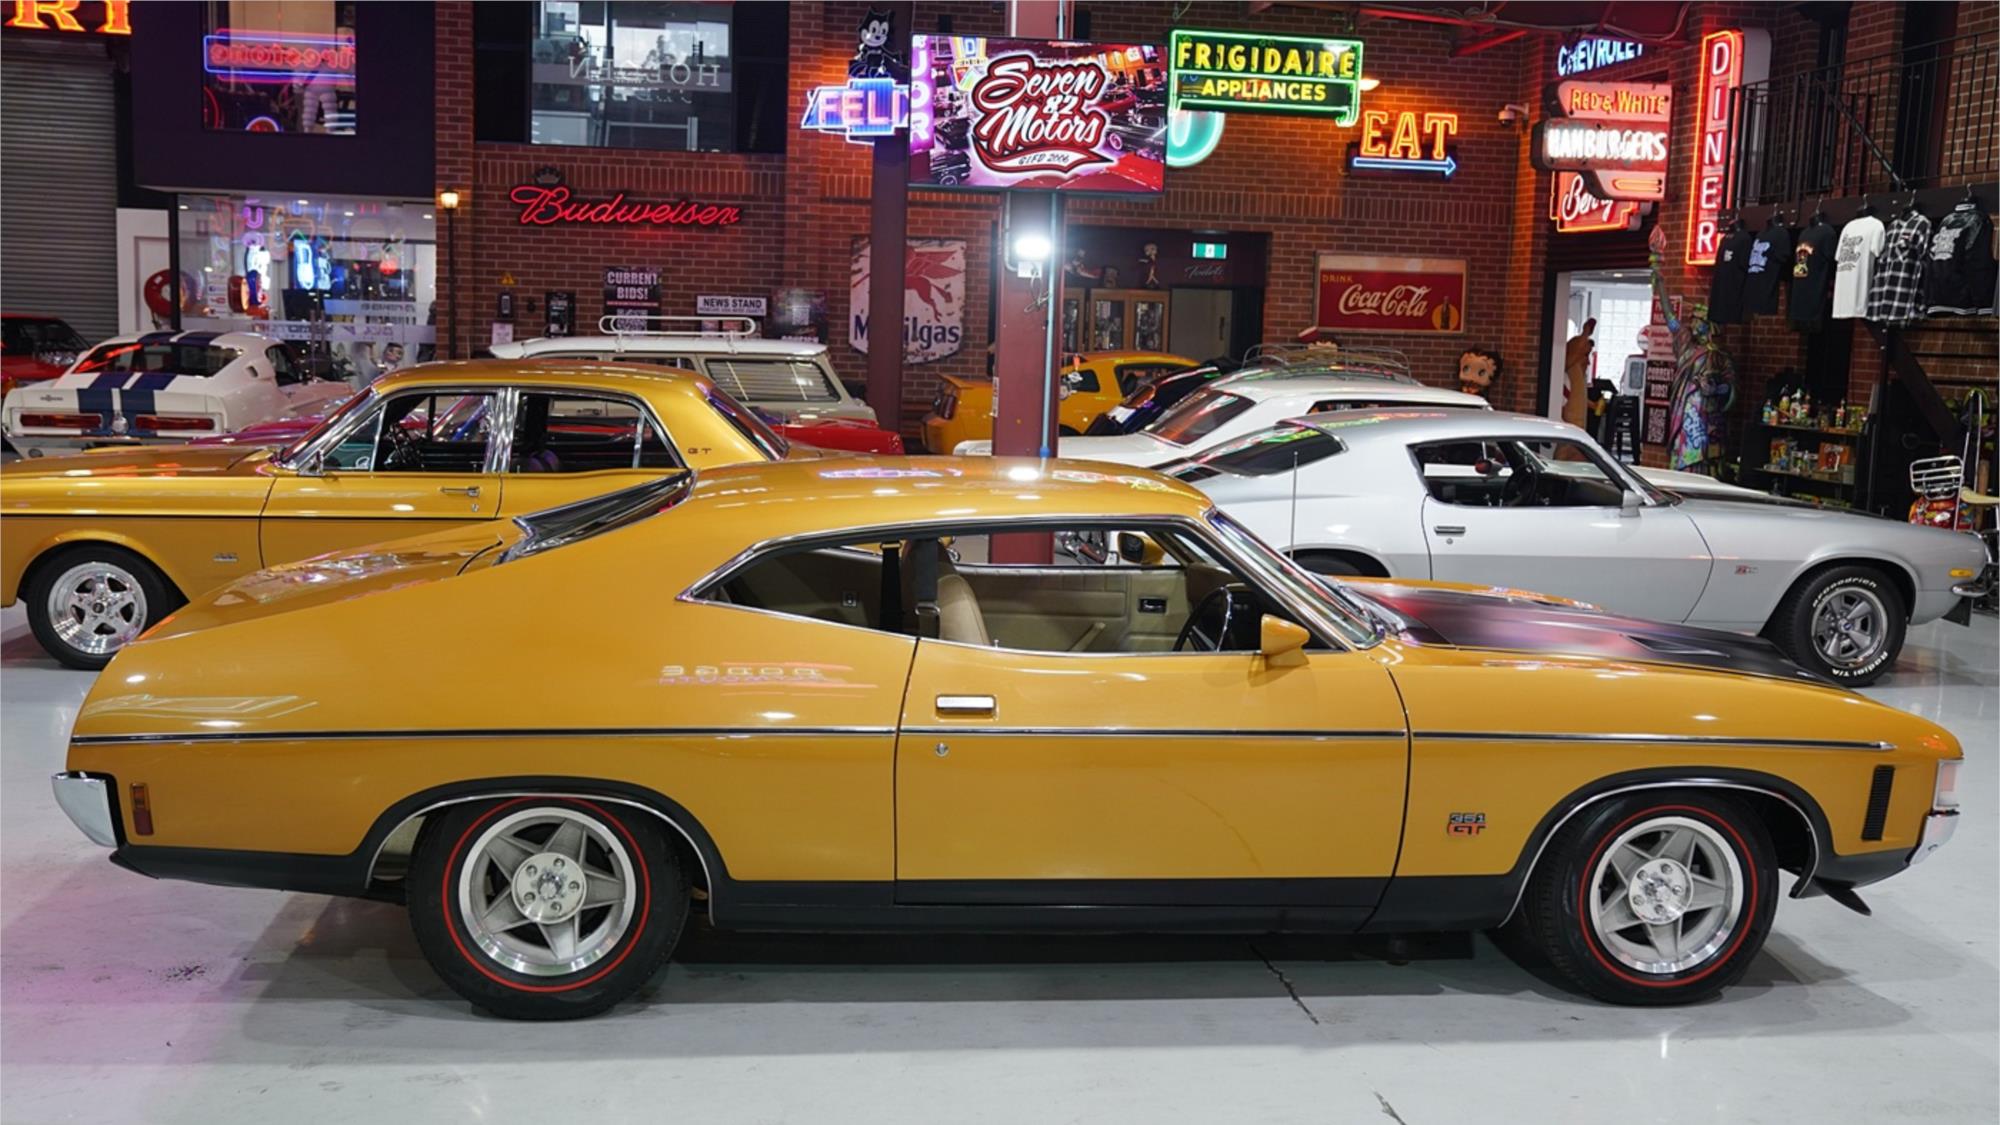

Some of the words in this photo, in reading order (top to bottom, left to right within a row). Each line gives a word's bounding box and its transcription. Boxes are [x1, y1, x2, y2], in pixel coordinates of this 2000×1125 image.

[1177, 42, 1355, 77] FRIGIDAIRE
[978, 60, 1099, 108] Seven
[1201, 79, 1326, 101] APPLIANCES
[818, 90, 903, 126] FELI
[1043, 95, 1079, 115] 82
[1571, 88, 1600, 110] RED
[1616, 90, 1666, 115] WHITE
[979, 104, 1099, 153] Motors
[1360, 110, 1458, 161] EAT
[1547, 128, 1668, 162] HAMBURGERS
[1697, 42, 1729, 253] DINER
[511, 186, 739, 225] Budweiser
[607, 271, 658, 286] CURRENT
[616, 287, 648, 300] BIDS!
[1322, 274, 1353, 284] DRINK
[703, 297, 729, 308] NEWS
[731, 298, 762, 309] STAND
[1338, 283, 1432, 317] Coca-Cola
[854, 315, 960, 350] Milgas
[1447, 823, 1488, 837] GT
